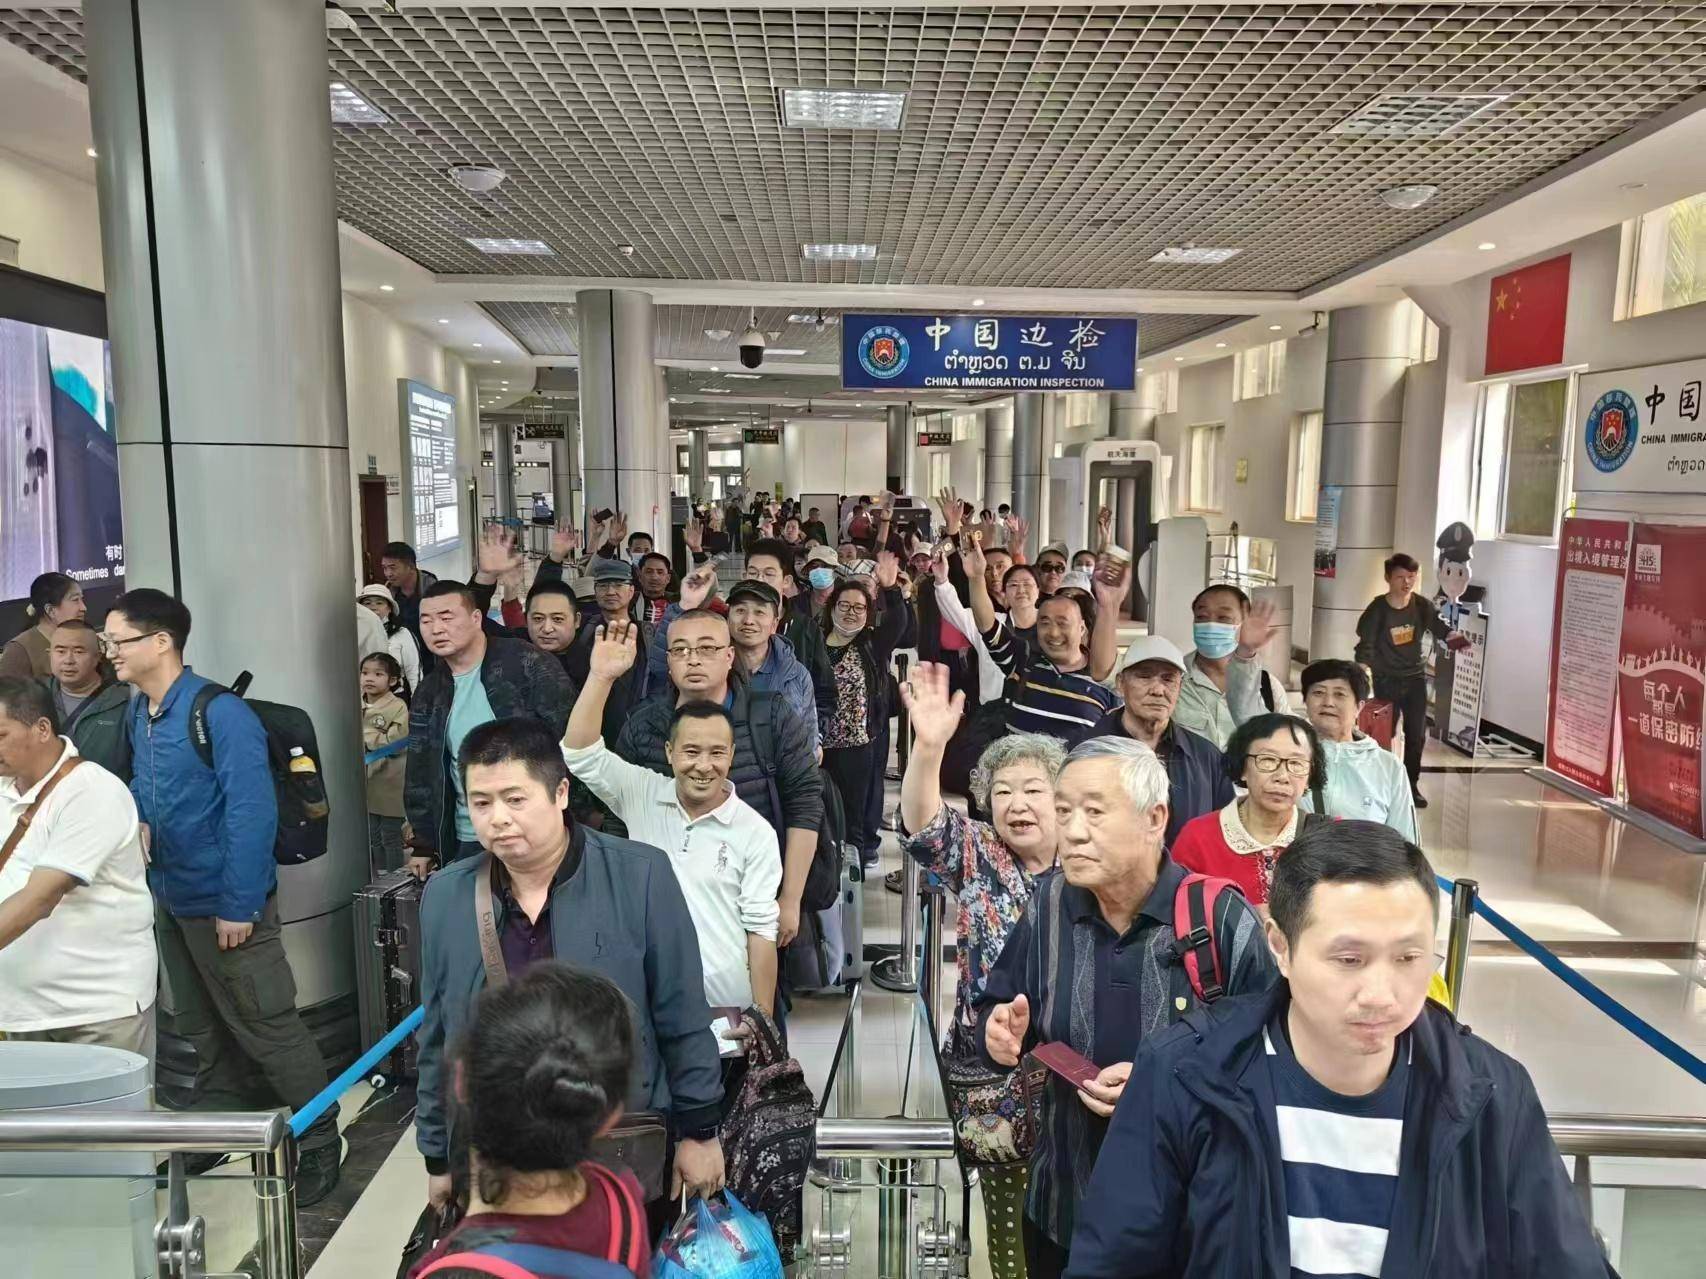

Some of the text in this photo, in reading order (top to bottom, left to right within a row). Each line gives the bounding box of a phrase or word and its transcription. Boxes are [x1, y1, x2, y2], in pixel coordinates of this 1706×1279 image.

[925, 317, 1106, 351] 中国边检
[924, 376, 1105, 388] CHINA IMMIGRATION INSPECTION
[1645, 380, 1702, 425] 中国
[1641, 434, 1666, 445] CHINA
[65, 566, 109, 581] Sometimes
[1643, 679, 1686, 710] 每个人
